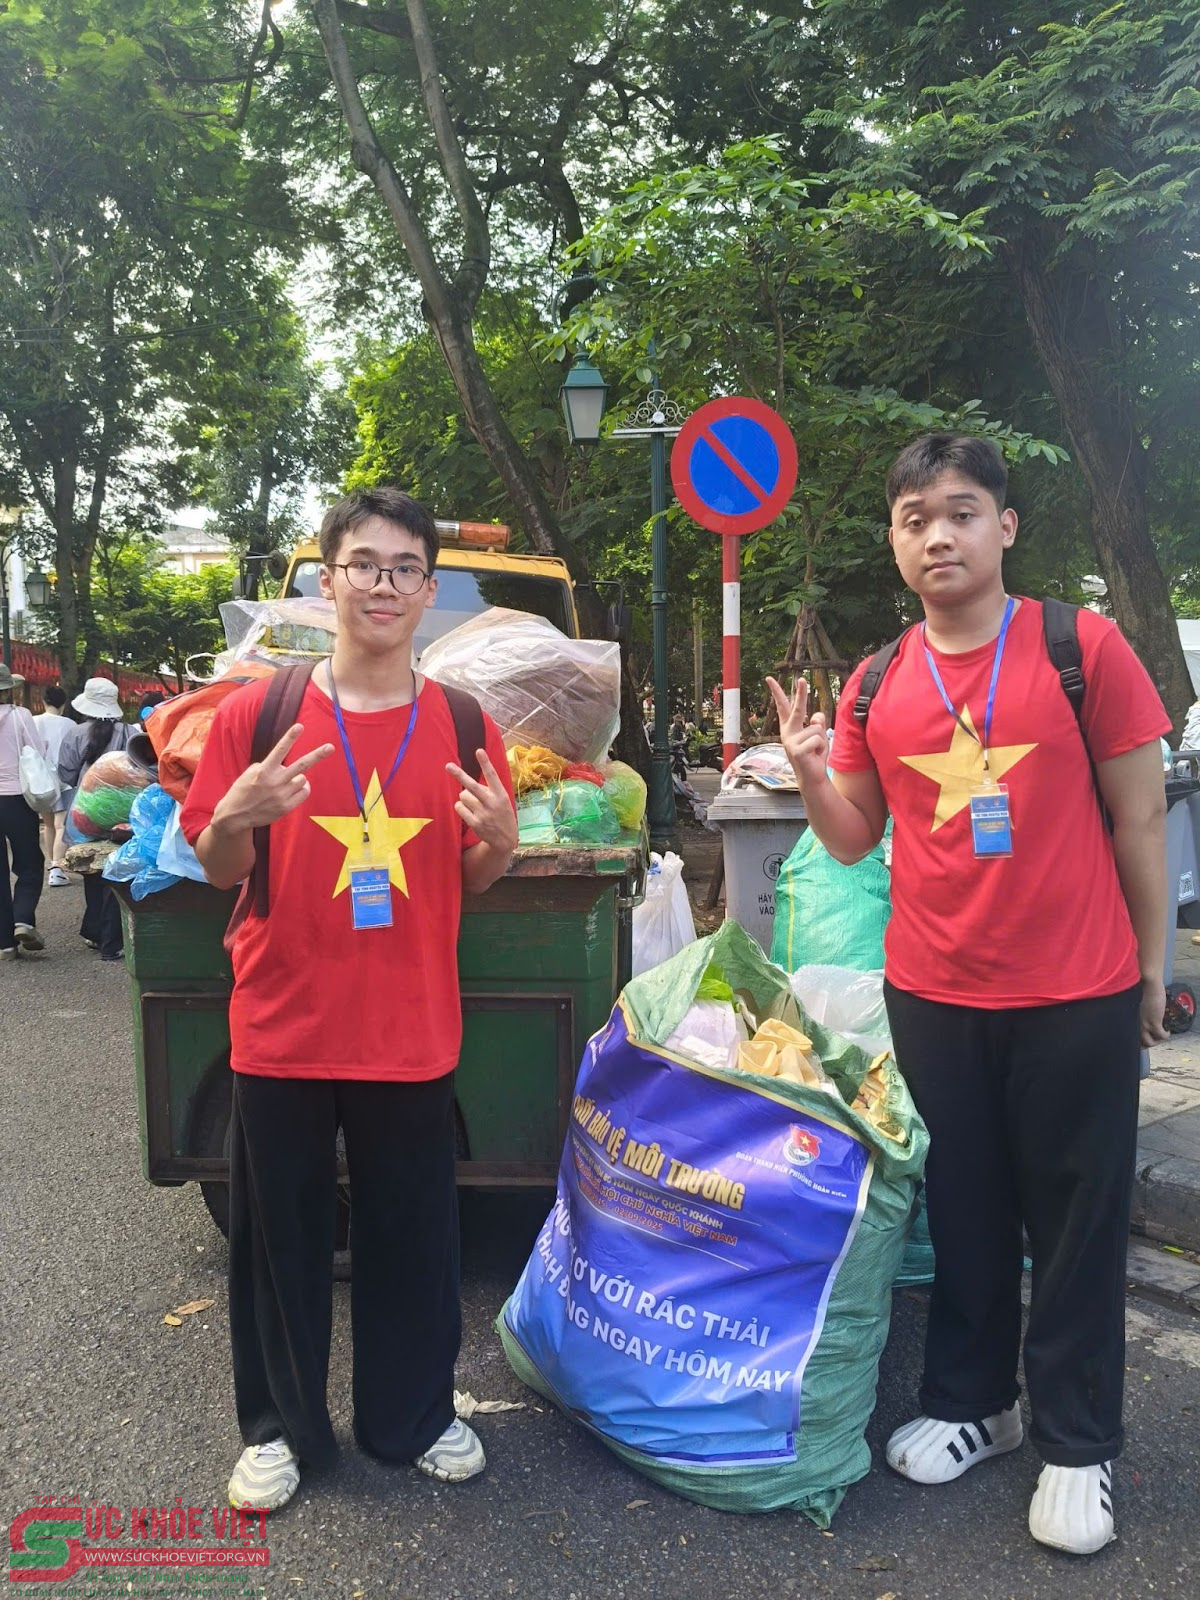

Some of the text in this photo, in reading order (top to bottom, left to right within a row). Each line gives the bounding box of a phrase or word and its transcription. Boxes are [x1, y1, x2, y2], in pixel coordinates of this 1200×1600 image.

[758, 893, 772, 903] HÃY
[759, 904, 775, 915] VÀO
[586, 1109, 611, 1146] BẢO
[606, 1127, 626, 1164] VỆ
[622, 1140, 666, 1180] MÔI
[665, 1158, 746, 1211] TRƯỜNG
[600, 1186, 620, 1202] HỘI
[621, 1194, 645, 1211] CHỦ
[645, 1205, 682, 1228] NGHĨA
[682, 1219, 709, 1238] VIỆT
[709, 1230, 738, 1247] NAM
[662, 1199, 688, 1216] QUỐC
[688, 1209, 724, 1229] KHÁNH
[589, 1267, 635, 1308] VỚI
[635, 1290, 696, 1330] RÁC
[702, 1311, 771, 1348] THẢI
[592, 1316, 662, 1366] NGAY
[664, 1349, 733, 1385] HÔM
[735, 1368, 791, 1393] NAY
